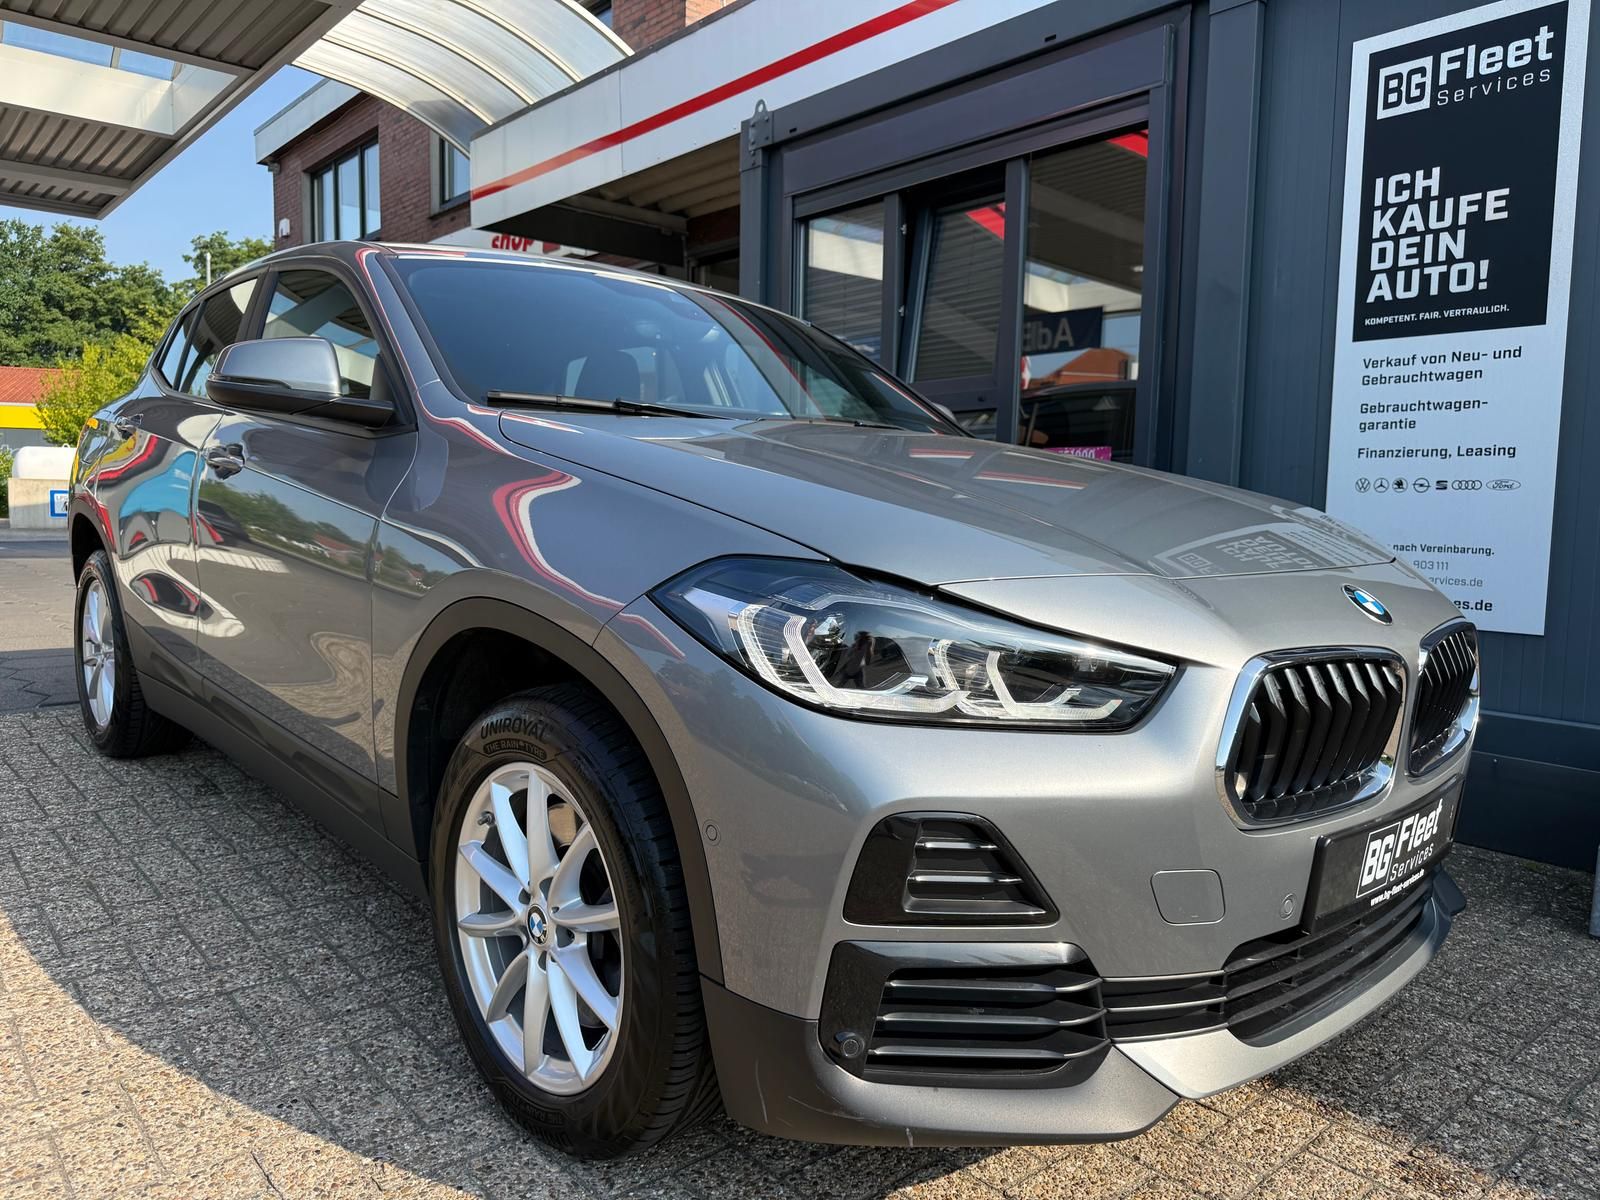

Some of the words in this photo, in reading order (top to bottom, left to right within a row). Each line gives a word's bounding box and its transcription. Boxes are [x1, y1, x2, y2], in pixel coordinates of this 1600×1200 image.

[1380, 64, 1429, 114] BG
[1438, 25, 1554, 86] Fleet
[1437, 68, 1550, 106] Services
[1374, 166, 1440, 207] ICH
[1372, 188, 1510, 239] KAUFE
[1370, 229, 1466, 271] DEIN
[1366, 259, 1490, 303] AUTO!
[1364, 313, 1418, 326] KOMPETENT.
[1419, 310, 1442, 321] FAIR.
[1443, 304, 1510, 319] VERTRAULICH.
[1363, 354, 1417, 370] Verkauf
[1421, 353, 1447, 366] von
[1451, 351, 1488, 363] Neu-
[1493, 346, 1522, 360] und
[1361, 368, 1483, 387] Gebrauchtwagen
[1360, 398, 1488, 415] Gebrauchtwagen-
[1359, 418, 1416, 433] garantie
[1357, 446, 1452, 461] Finanzierung,
[1457, 445, 1517, 459] Leasing
[1393, 543, 1417, 552] nach
[1420, 544, 1495, 556] Vereinbarung.
[481, 717, 547, 742] UNIROYAL
[1360, 831, 1397, 889] BG
[1395, 798, 1443, 858] Fleet
[1390, 843, 1434, 882] Services
